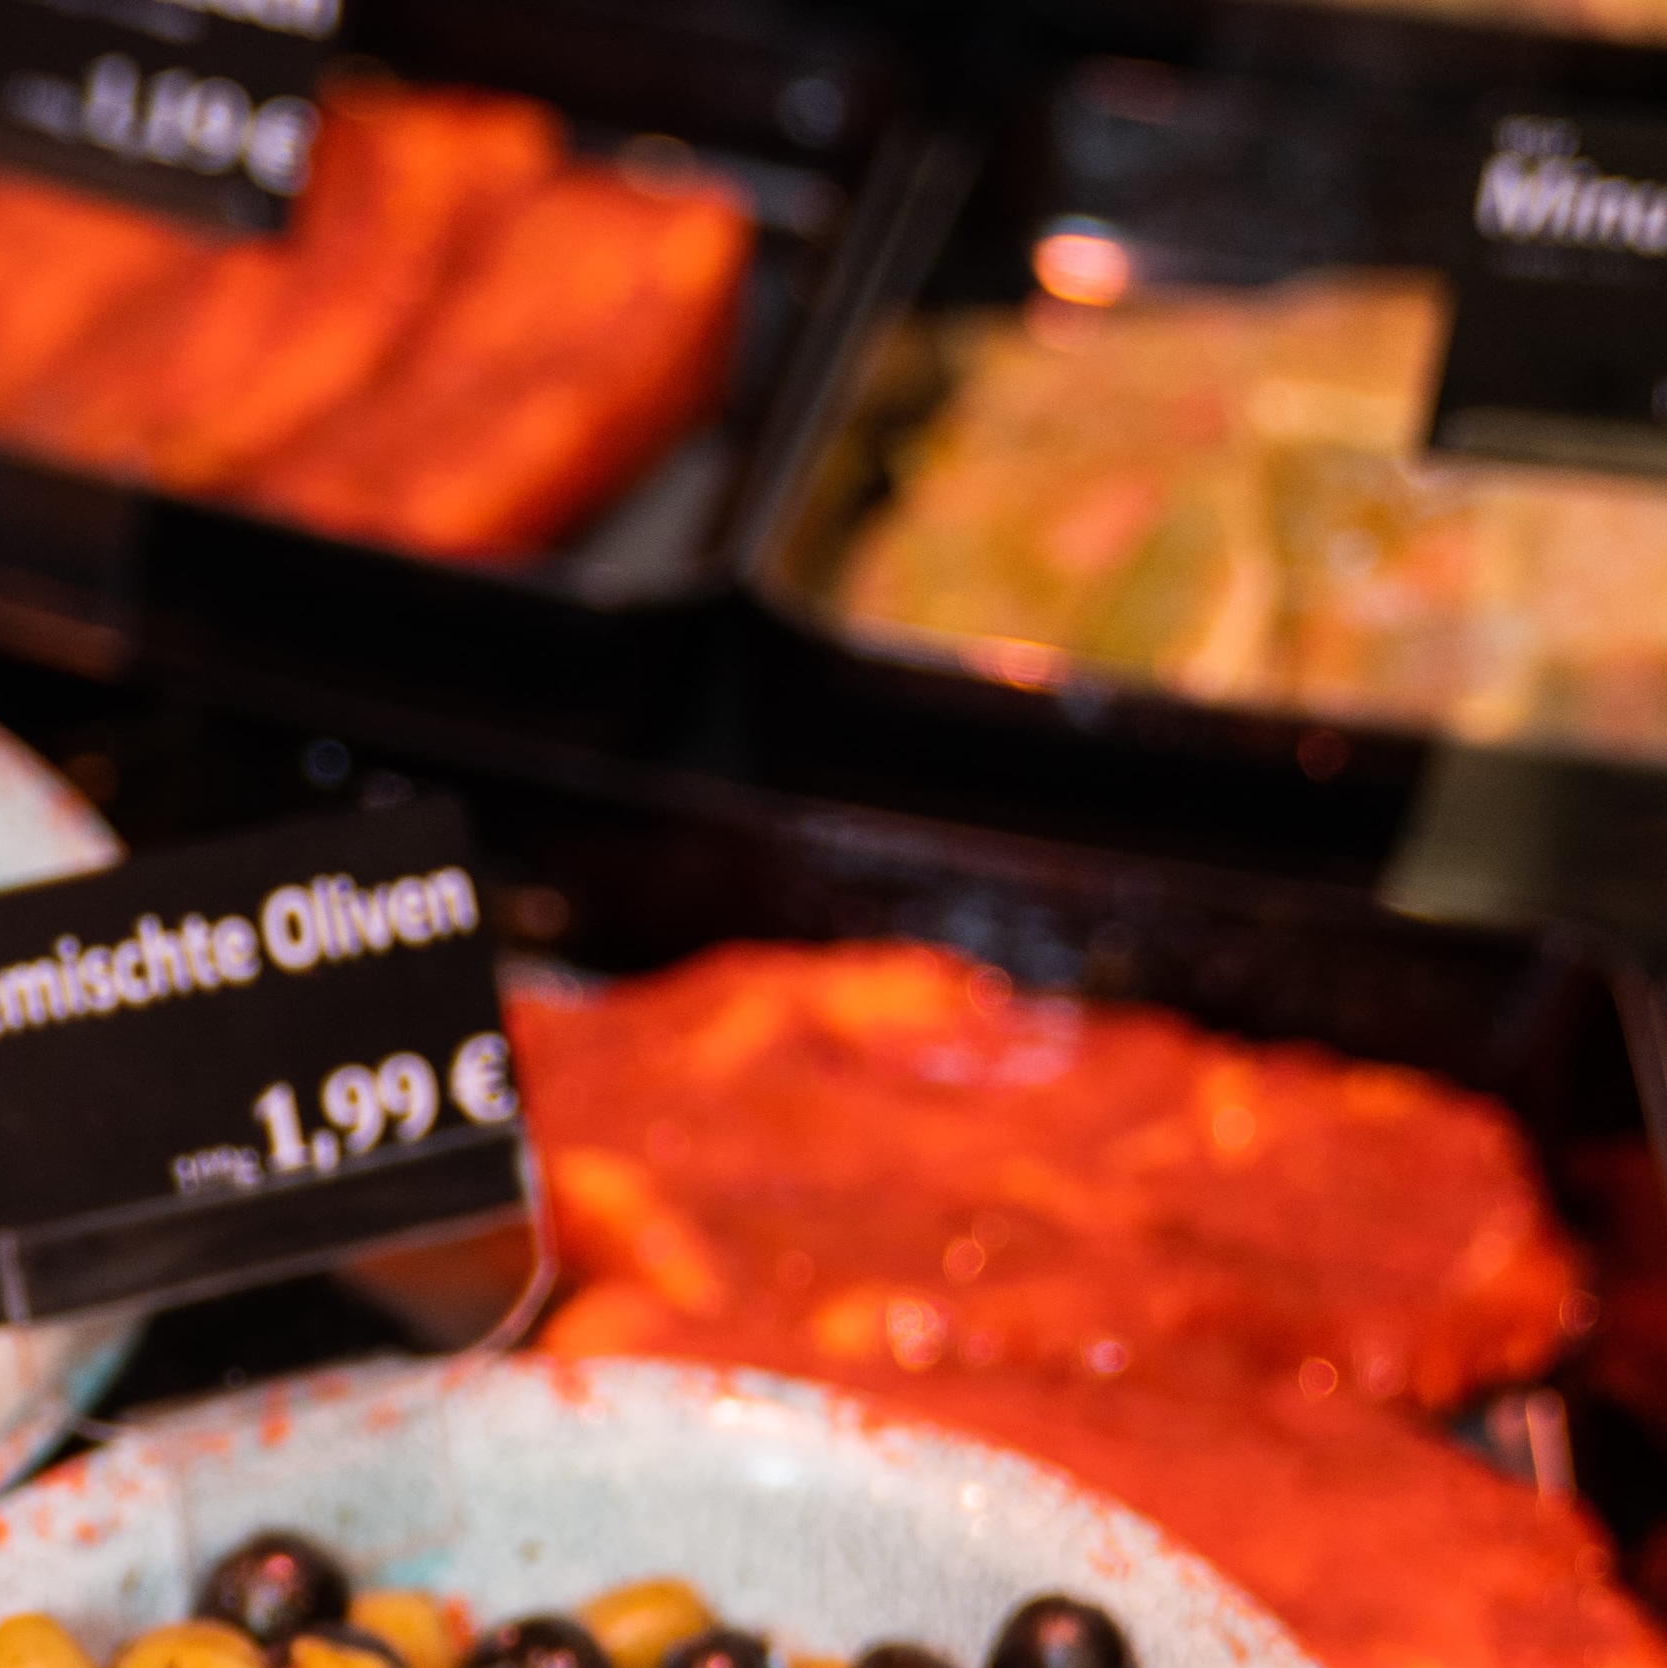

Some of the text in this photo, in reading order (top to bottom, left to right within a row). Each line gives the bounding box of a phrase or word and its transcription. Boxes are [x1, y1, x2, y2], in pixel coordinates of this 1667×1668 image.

[259, 866, 479, 972] Oliven
[253, 1050, 439, 1176] 1,99
[449, 1030, 517, 1124] €
